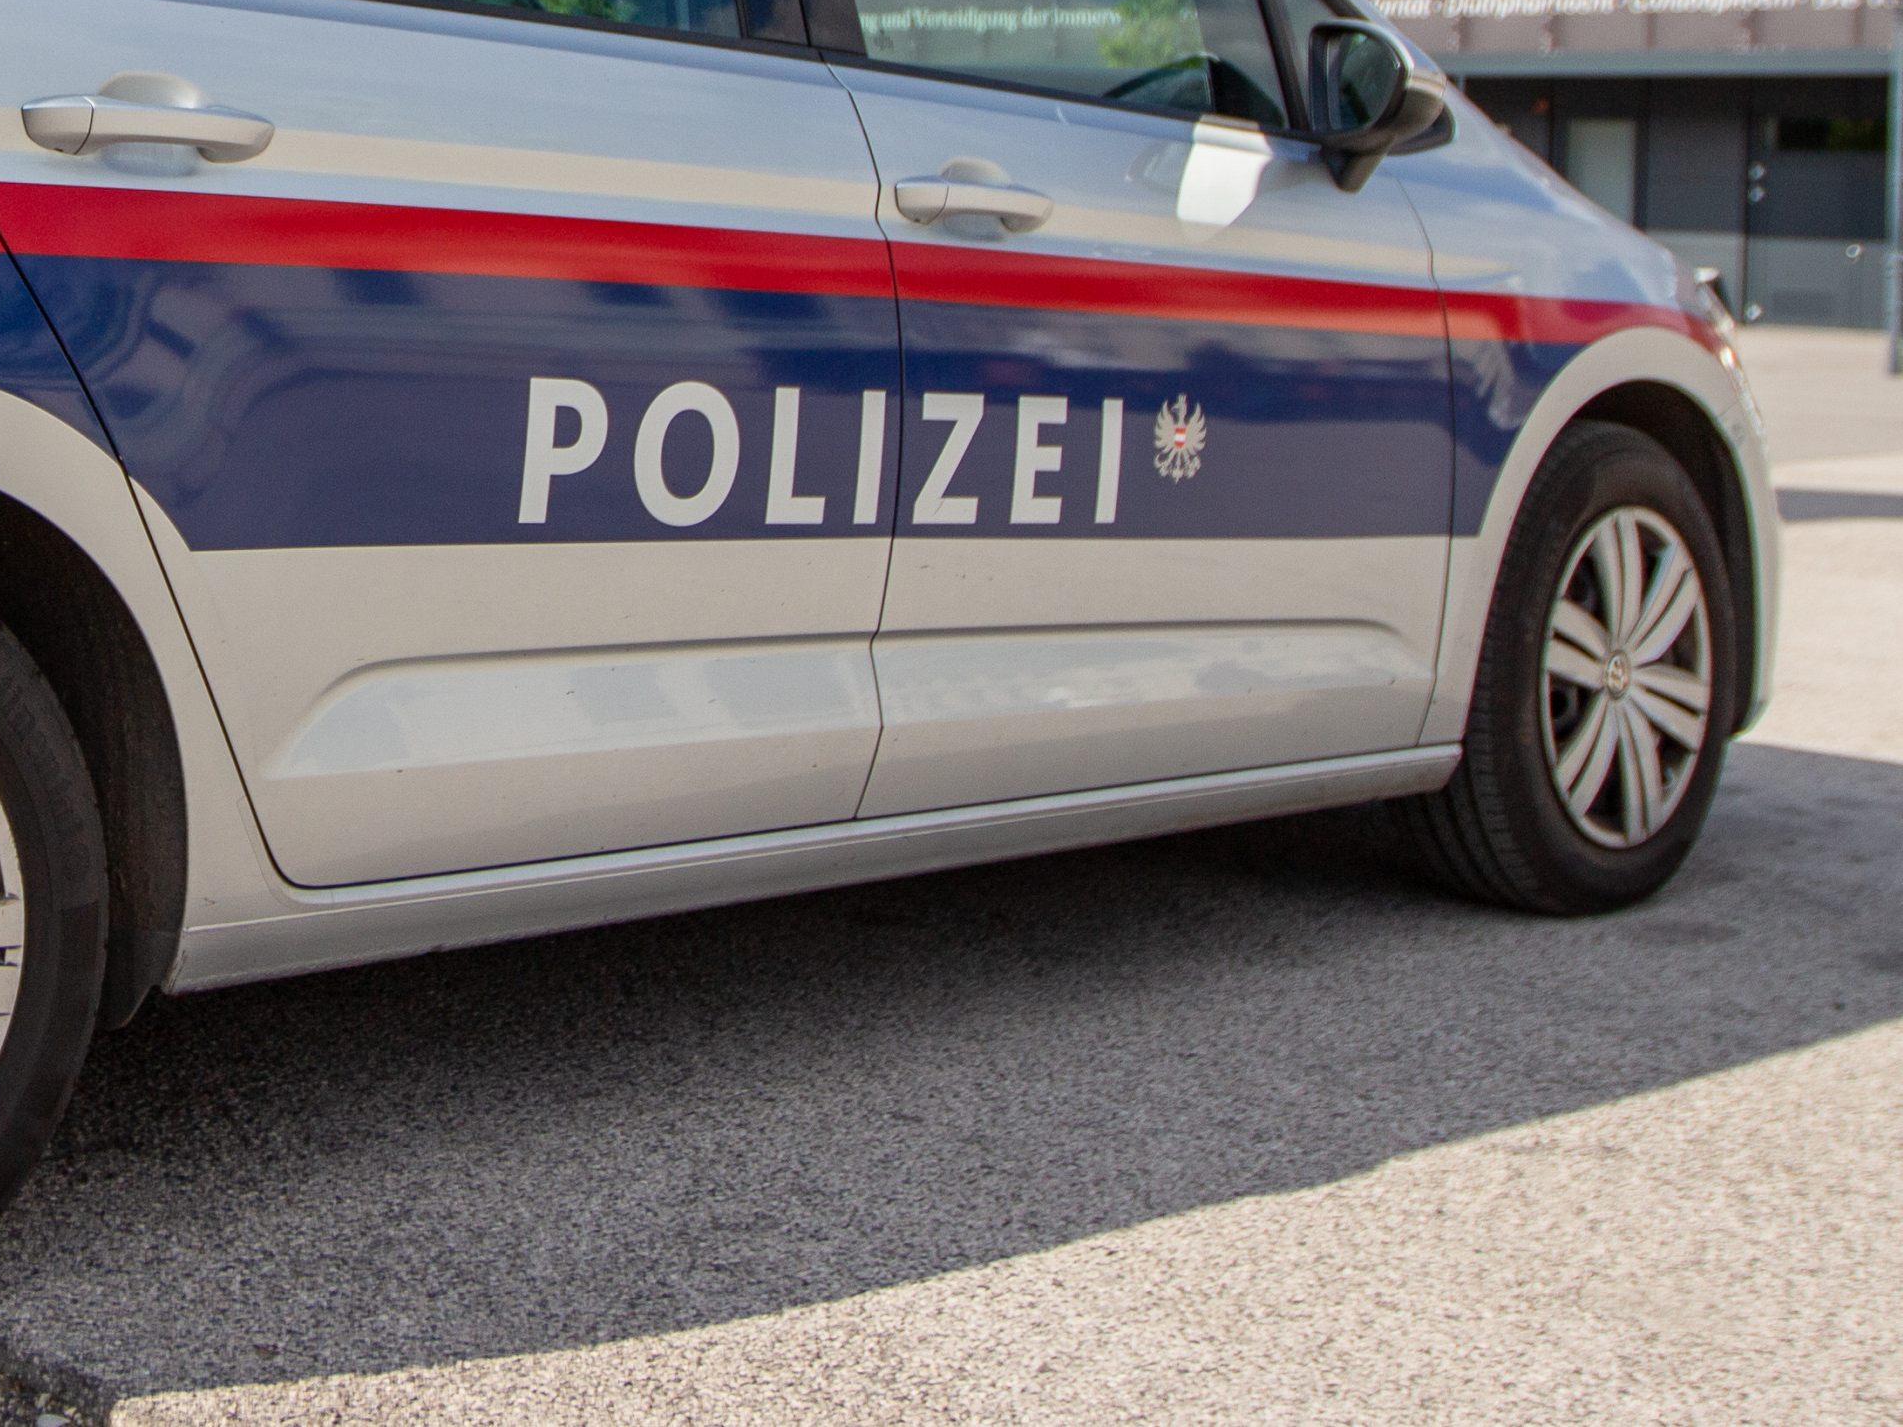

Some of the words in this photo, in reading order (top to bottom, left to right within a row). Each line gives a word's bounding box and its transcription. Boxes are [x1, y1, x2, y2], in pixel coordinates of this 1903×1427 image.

[881, 8, 911, 29] und
[913, 7, 1018, 35] Verteidigung
[1020, 5, 1053, 28] der
[1054, 6, 1122, 28] immerw
[517, 376, 1124, 528] POLIZEI
